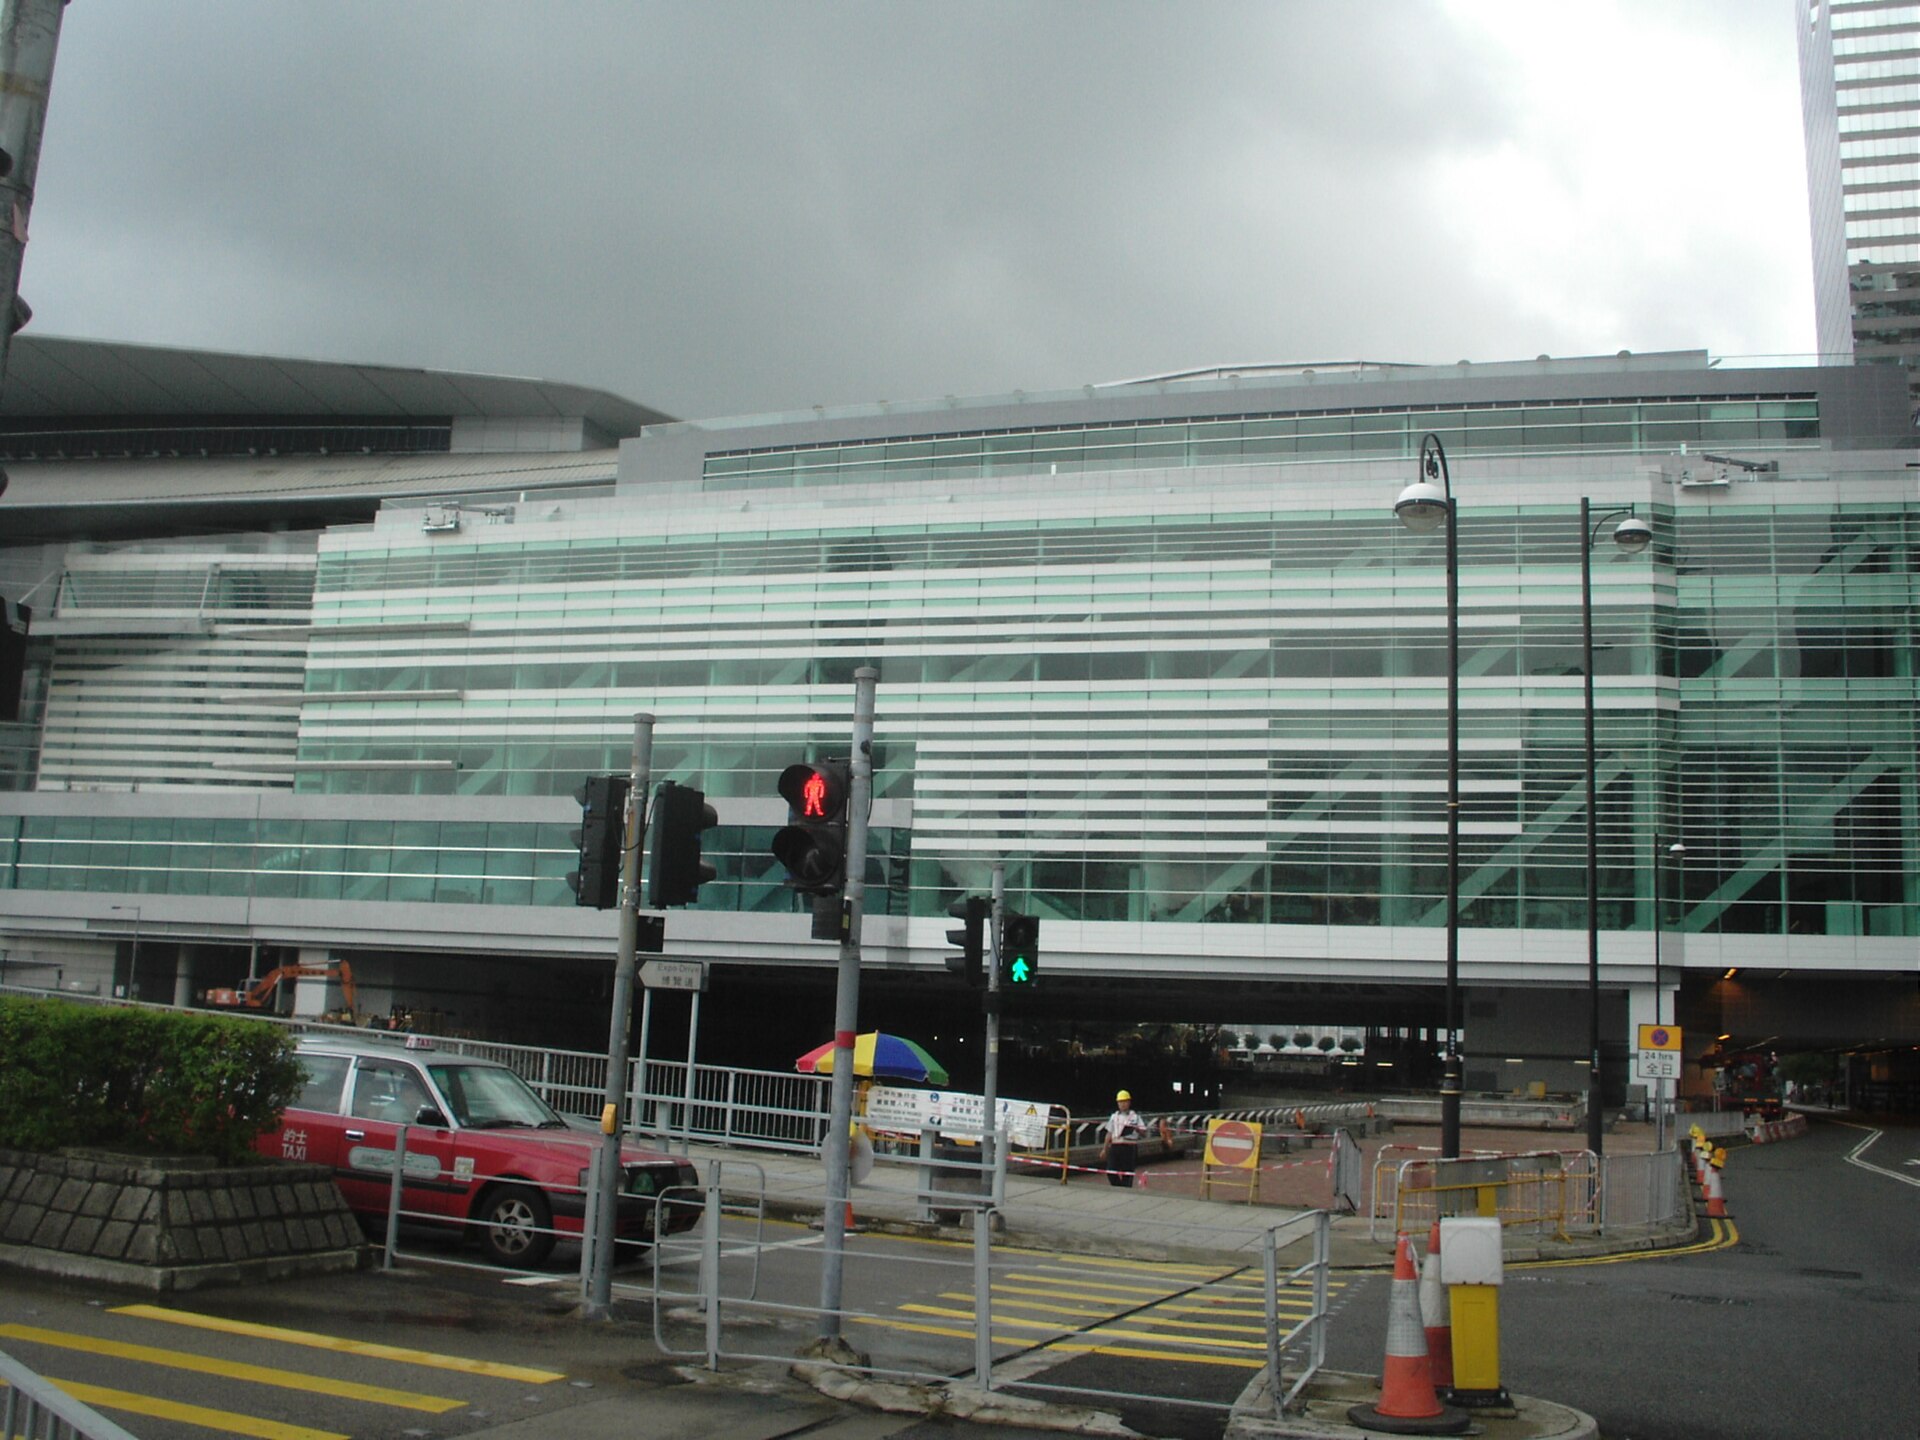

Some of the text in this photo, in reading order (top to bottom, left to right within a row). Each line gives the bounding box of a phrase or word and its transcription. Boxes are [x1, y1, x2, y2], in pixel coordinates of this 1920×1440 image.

[657, 963, 700, 973] Expo Drive
[1645, 1051, 1673, 1060] 24 hrs
[1646, 1063, 1672, 1075] 全日
[283, 1128, 307, 1145] 的士
[282, 1143, 306, 1160] TAXI
